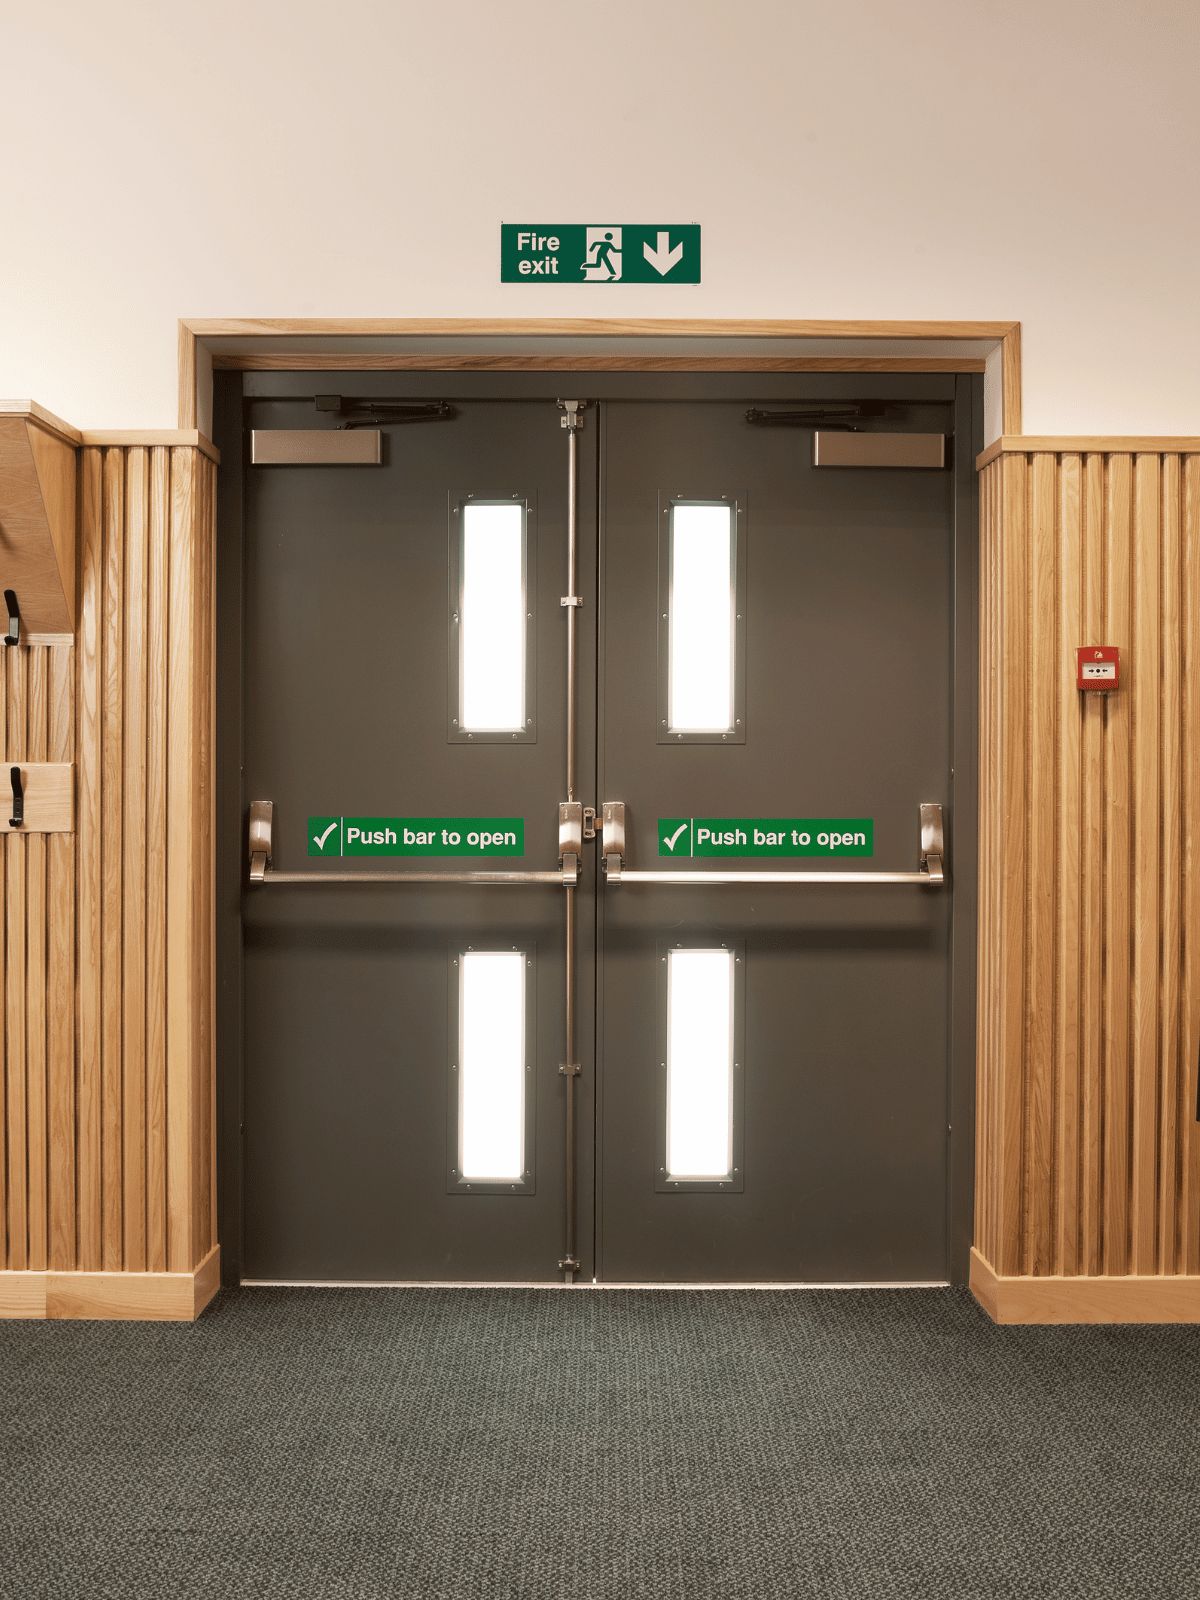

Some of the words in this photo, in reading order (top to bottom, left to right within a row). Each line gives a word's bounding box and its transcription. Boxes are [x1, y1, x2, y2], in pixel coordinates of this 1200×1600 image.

[518, 232, 560, 251] Fire
[518, 256, 559, 275] exit
[347, 828, 397, 845] Push
[403, 828, 436, 845] bar
[441, 830, 461, 845] to
[466, 832, 517, 850] open
[697, 828, 747, 845] Push
[753, 829, 786, 846] bar
[791, 830, 811, 846] to
[816, 832, 866, 850] open
